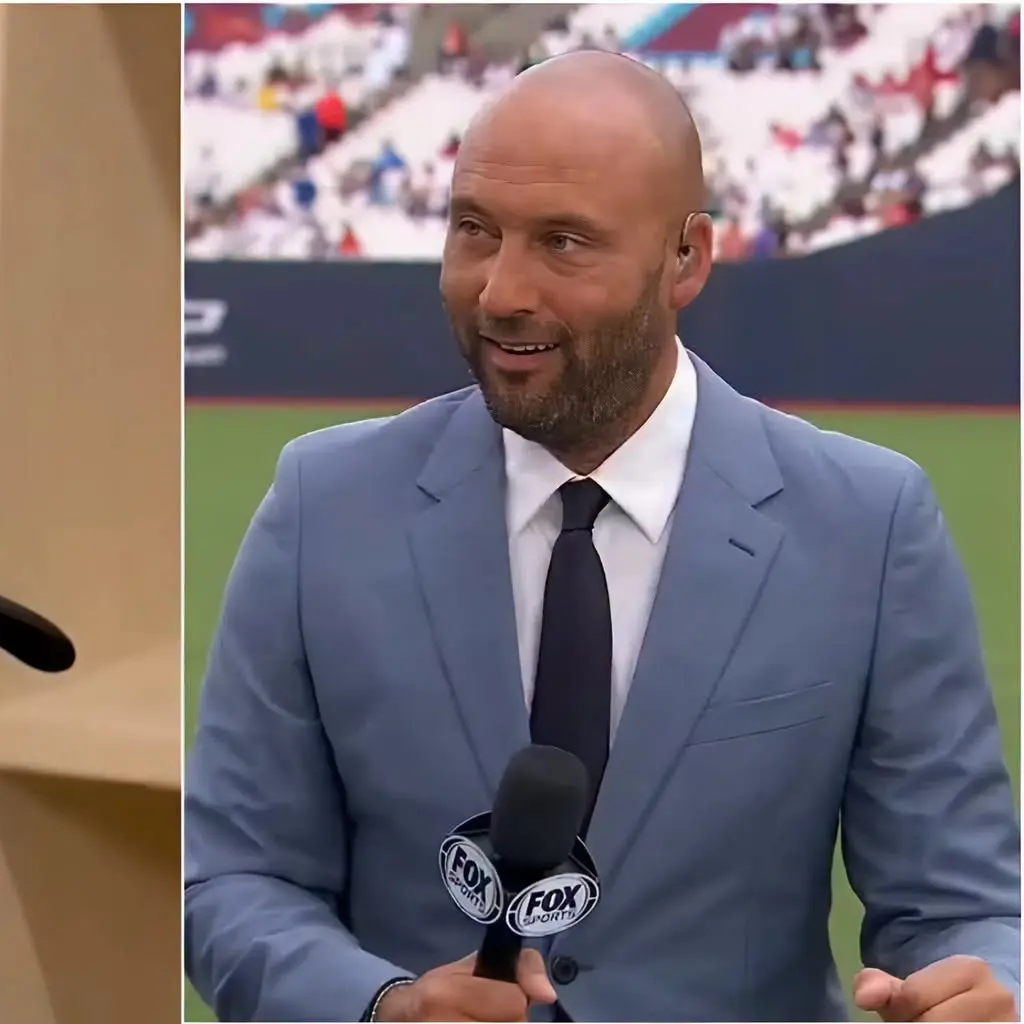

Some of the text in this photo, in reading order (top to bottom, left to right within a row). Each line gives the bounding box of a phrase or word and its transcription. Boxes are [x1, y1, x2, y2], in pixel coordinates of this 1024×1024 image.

[450, 846, 492, 899] FOX
[526, 884, 582, 916] FOX
[523, 910, 576, 926] SPORTS
